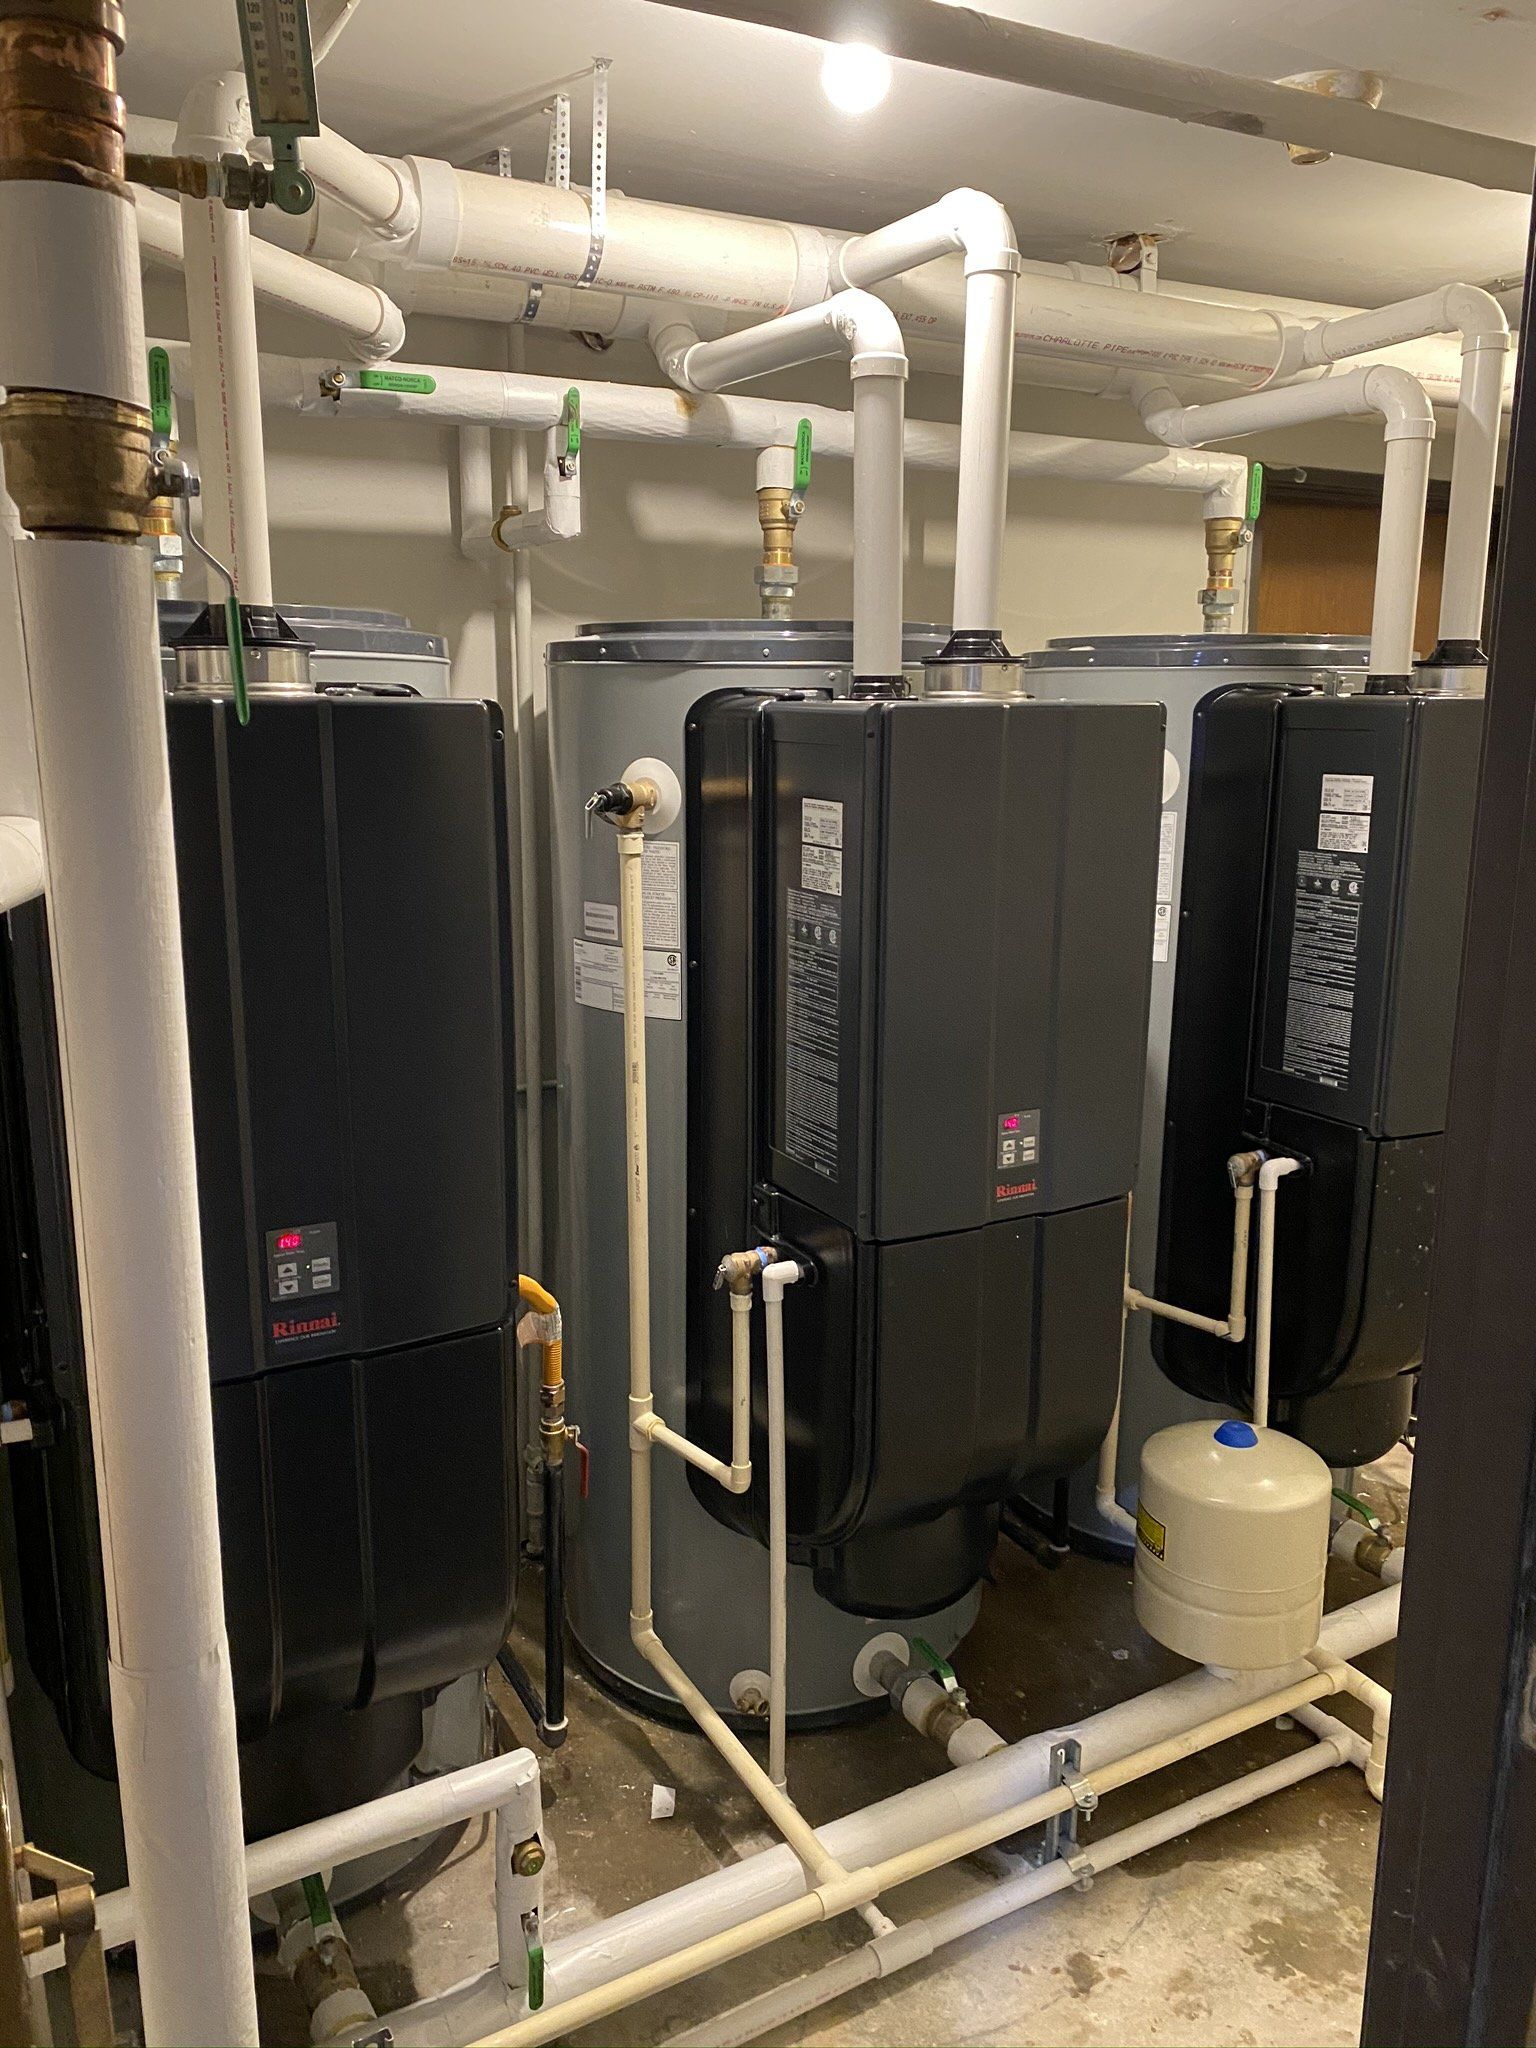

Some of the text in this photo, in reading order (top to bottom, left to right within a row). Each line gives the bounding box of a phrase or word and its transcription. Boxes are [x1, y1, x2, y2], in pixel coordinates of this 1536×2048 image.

[1043, 334, 1100, 349] CHARLOTTE
[1103, 343, 1130, 354] PIPE
[996, 1179, 1037, 1198] Rinnai
[272, 1312, 338, 1339] Rinnai
